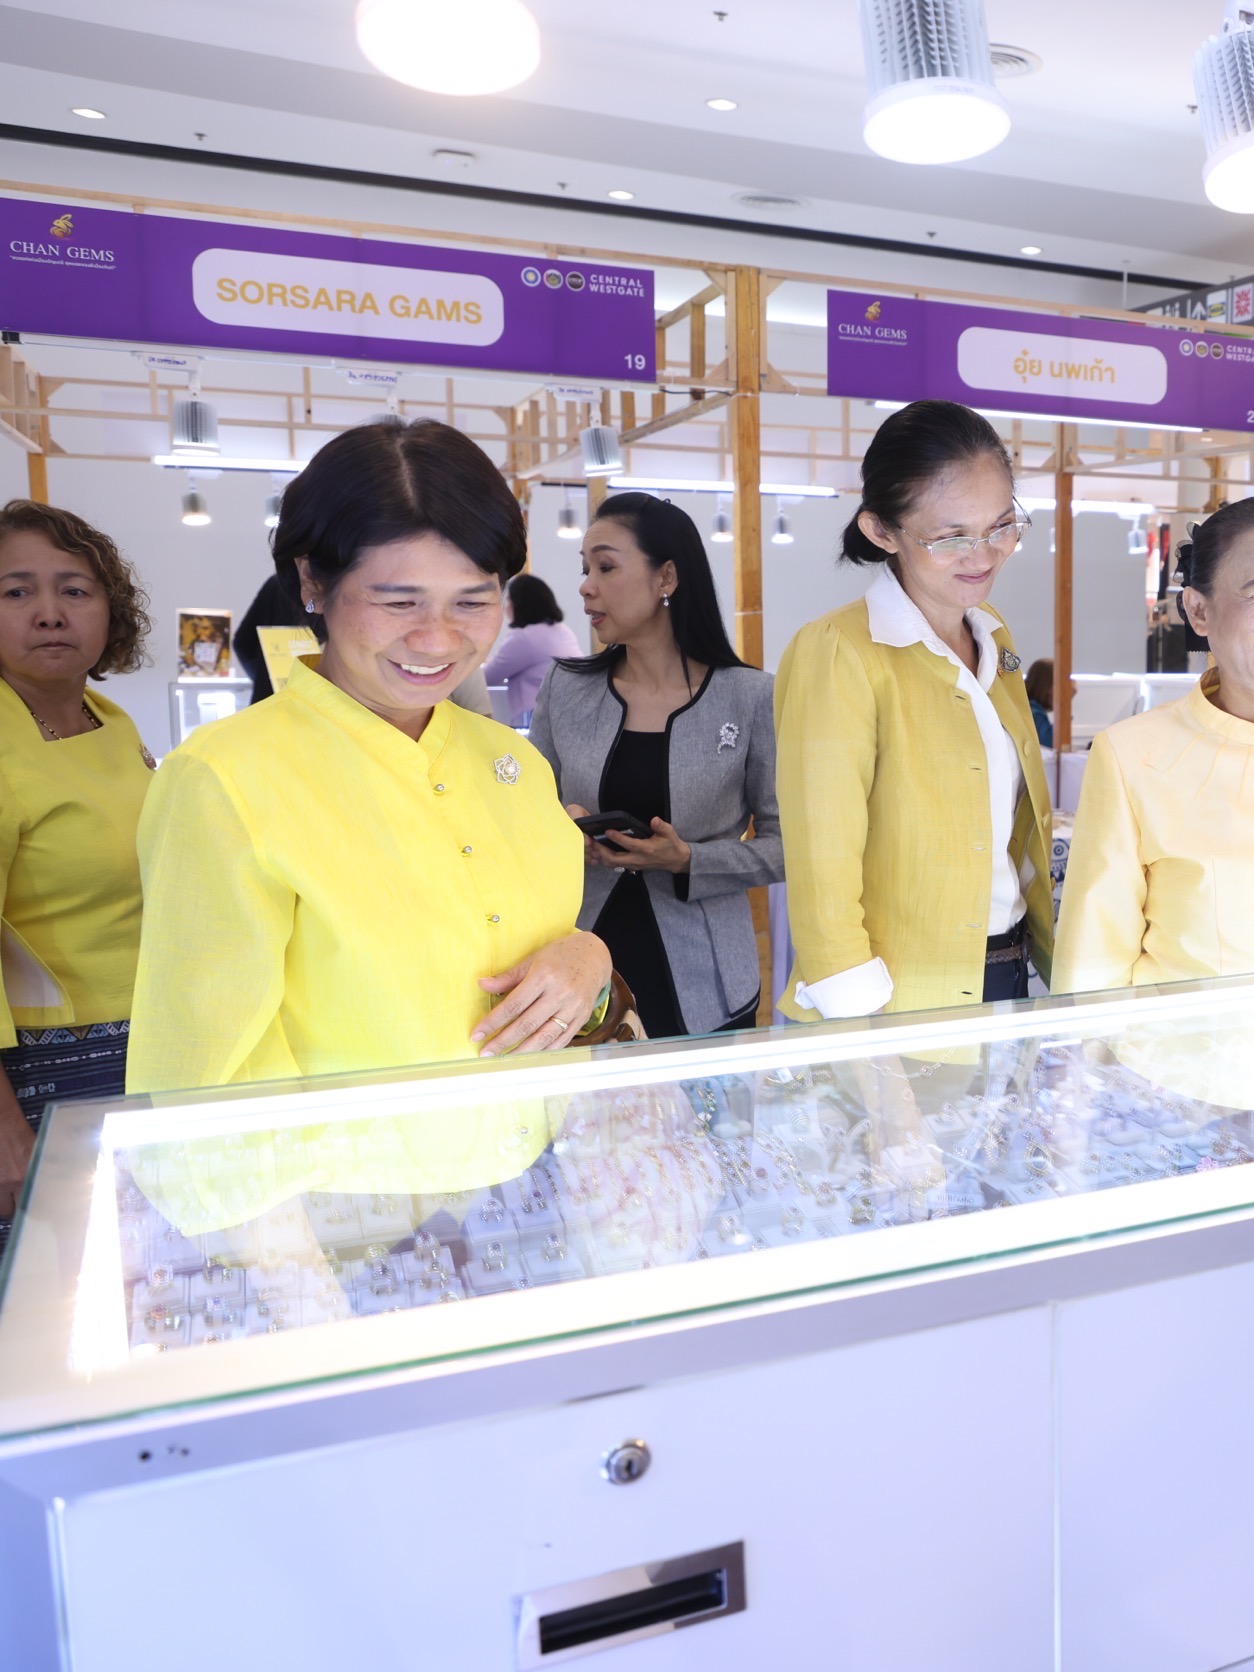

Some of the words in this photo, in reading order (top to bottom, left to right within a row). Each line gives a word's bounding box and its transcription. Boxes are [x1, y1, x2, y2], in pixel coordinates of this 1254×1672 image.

[10, 240, 60, 256] CHAN
[66, 246, 115, 262] GEMS
[590, 274, 643, 288] CENTRAL
[589, 283, 645, 297] WESTGATE
[216, 277, 380, 316] SORSARA
[389, 294, 482, 325] GAMS
[838, 323, 872, 336] CHAN
[875, 327, 908, 340] GEMS
[624, 353, 646, 370] 19
[1013, 349, 1042, 384] อุ๋ย
[1050, 358, 1115, 384] นพเก้า
